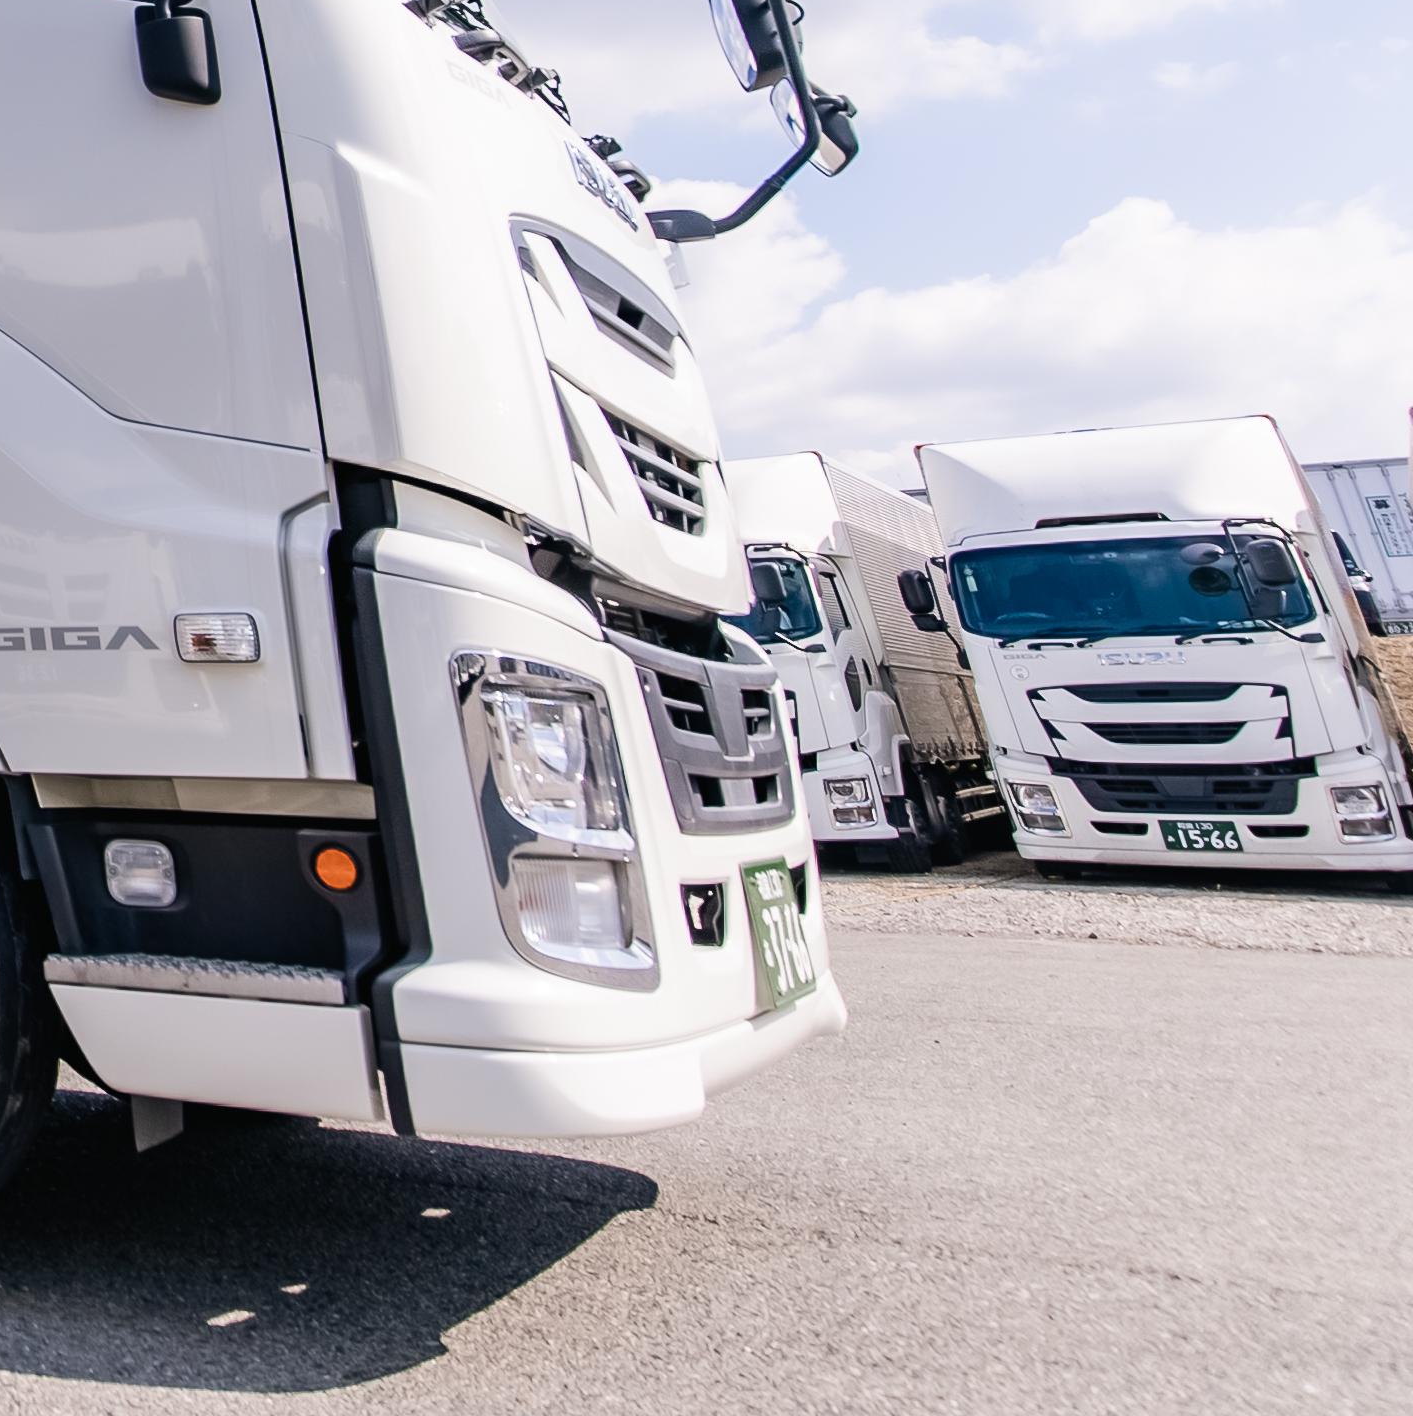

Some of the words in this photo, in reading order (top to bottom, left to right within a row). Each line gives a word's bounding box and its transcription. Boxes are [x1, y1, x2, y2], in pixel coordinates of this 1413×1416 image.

[444, 58, 514, 110] GIGA
[1097, 651, 1187, 666] ISUZU
[1177, 830, 1239, 850] 15-66
